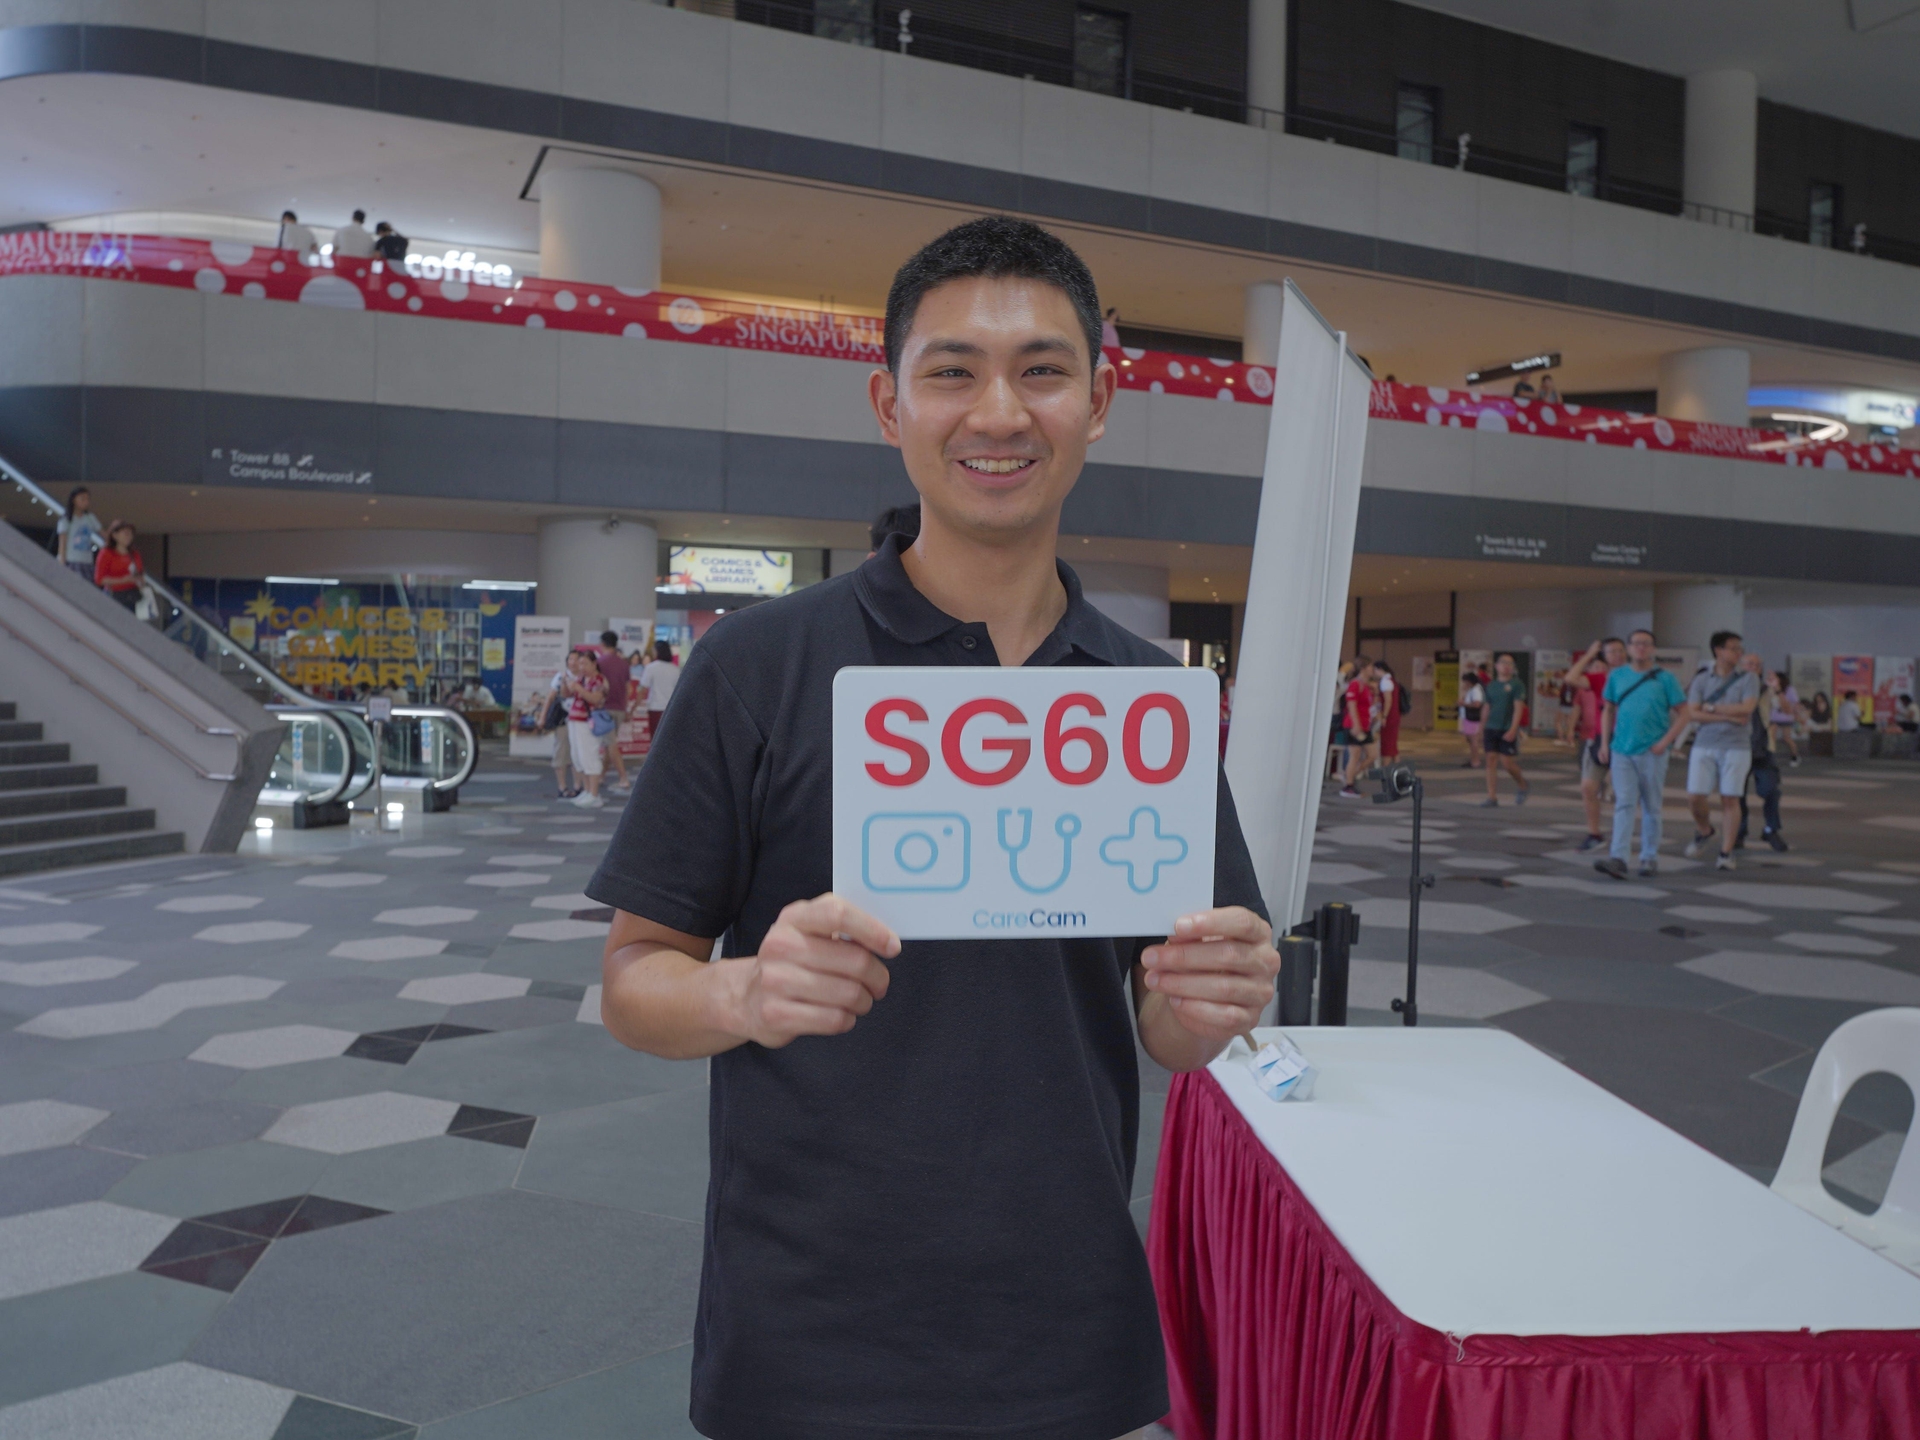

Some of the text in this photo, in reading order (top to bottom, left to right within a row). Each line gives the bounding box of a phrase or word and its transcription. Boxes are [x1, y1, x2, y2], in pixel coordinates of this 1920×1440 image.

[404, 250, 512, 288] coffee
[755, 303, 878, 337] MAJULAH
[735, 318, 883, 355] SINGAPURA
[230, 449, 270, 465] Tower
[229, 464, 354, 485] Campus Boulevard
[701, 557, 752, 567] COMICS
[709, 567, 754, 575] GAMES
[705, 576, 758, 584] LIBRARY
[270, 606, 449, 632] COMICS &
[287, 634, 417, 659] GAMES
[279, 662, 433, 687] LIBRARY
[864, 692, 1191, 787] SG60
[972, 908, 1087, 929] CareCam
